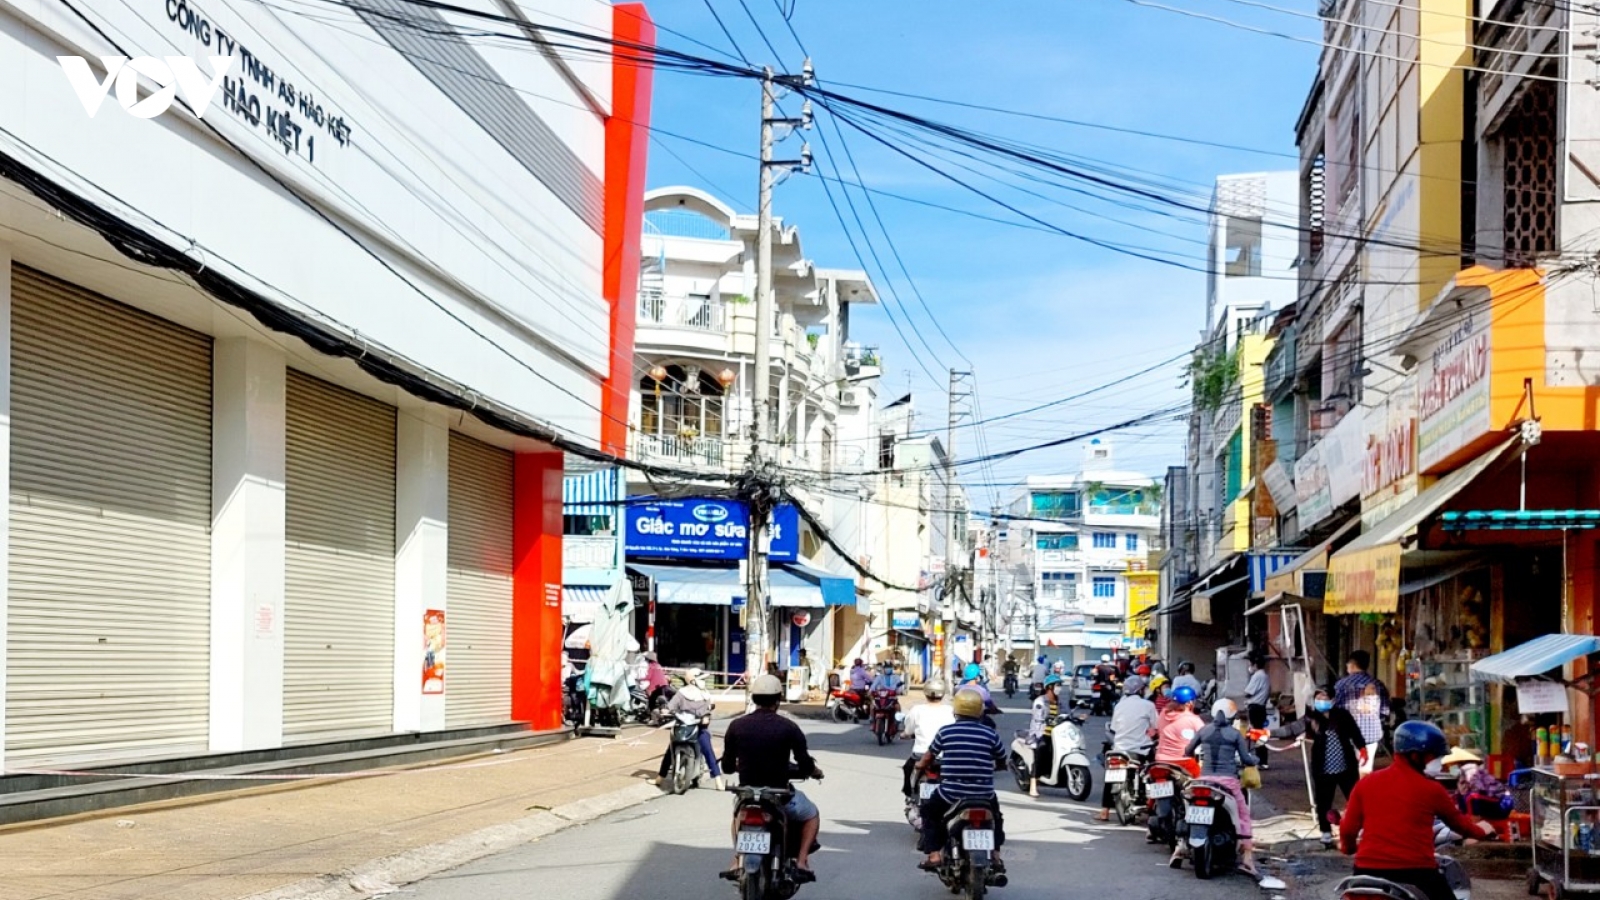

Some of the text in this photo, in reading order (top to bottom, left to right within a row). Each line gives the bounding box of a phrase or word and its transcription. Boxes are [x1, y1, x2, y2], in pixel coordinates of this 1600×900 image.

[166, 0, 211, 47] CÔNG
[215, 29, 235, 56] TY
[240, 45, 275, 93] TNHH
[279, 78, 296, 108] AS
[266, 106, 303, 155] KIỆT
[307, 136, 315, 163] 1
[679, 522, 710, 537] mơ
[714, 521, 746, 539] sữa
